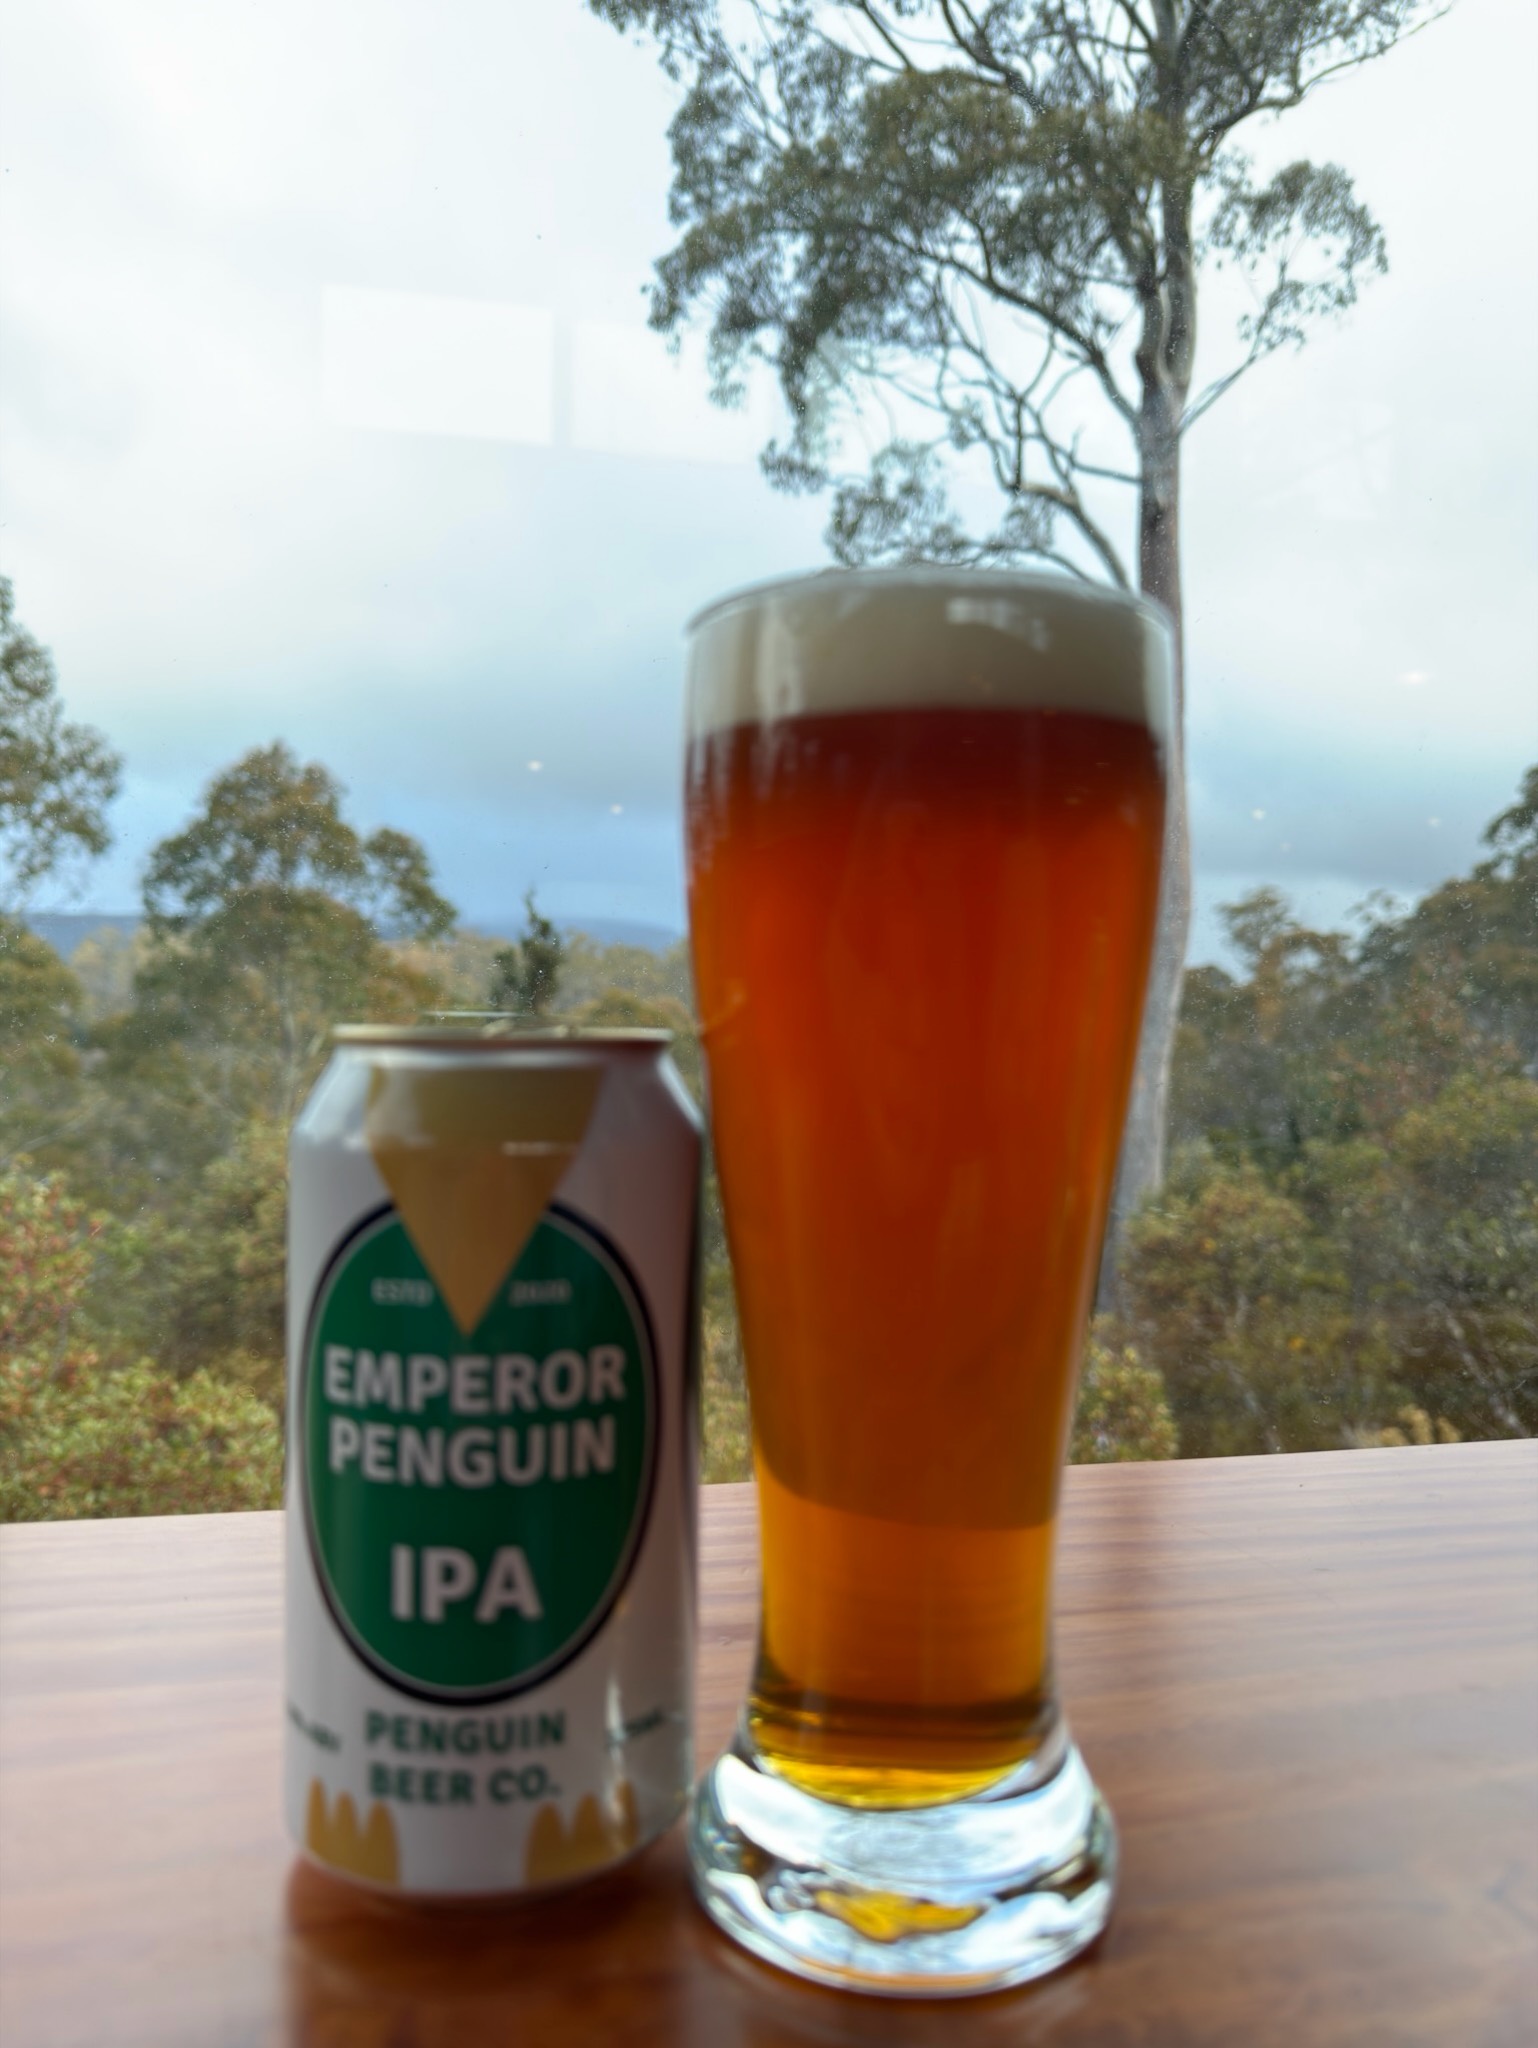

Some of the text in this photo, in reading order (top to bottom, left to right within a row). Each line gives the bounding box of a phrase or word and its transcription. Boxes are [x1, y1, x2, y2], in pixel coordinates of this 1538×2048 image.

[323, 1344, 627, 1415] EMPEROR
[328, 1414, 617, 1488] PENGUIN
[391, 1544, 543, 1623] IPA
[365, 1708, 566, 1756] PENGUIN
[369, 1763, 562, 1803] BEER CO.
